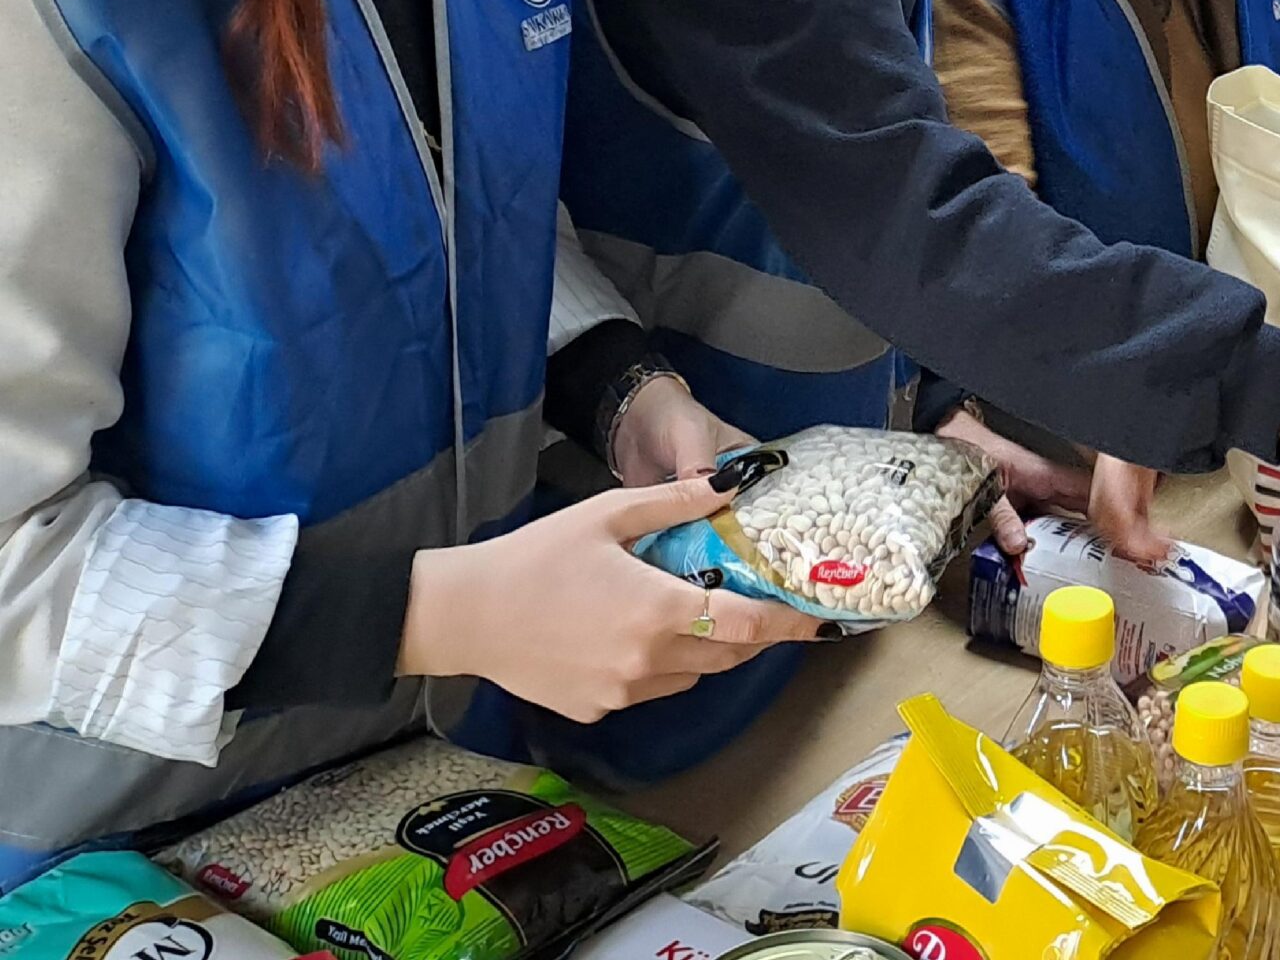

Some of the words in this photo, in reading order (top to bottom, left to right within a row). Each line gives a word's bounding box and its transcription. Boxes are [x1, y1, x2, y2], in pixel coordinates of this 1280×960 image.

[414, 795, 492, 836] Mercimek
[448, 810, 488, 833] Yeşil
[468, 811, 573, 875] Rençber
